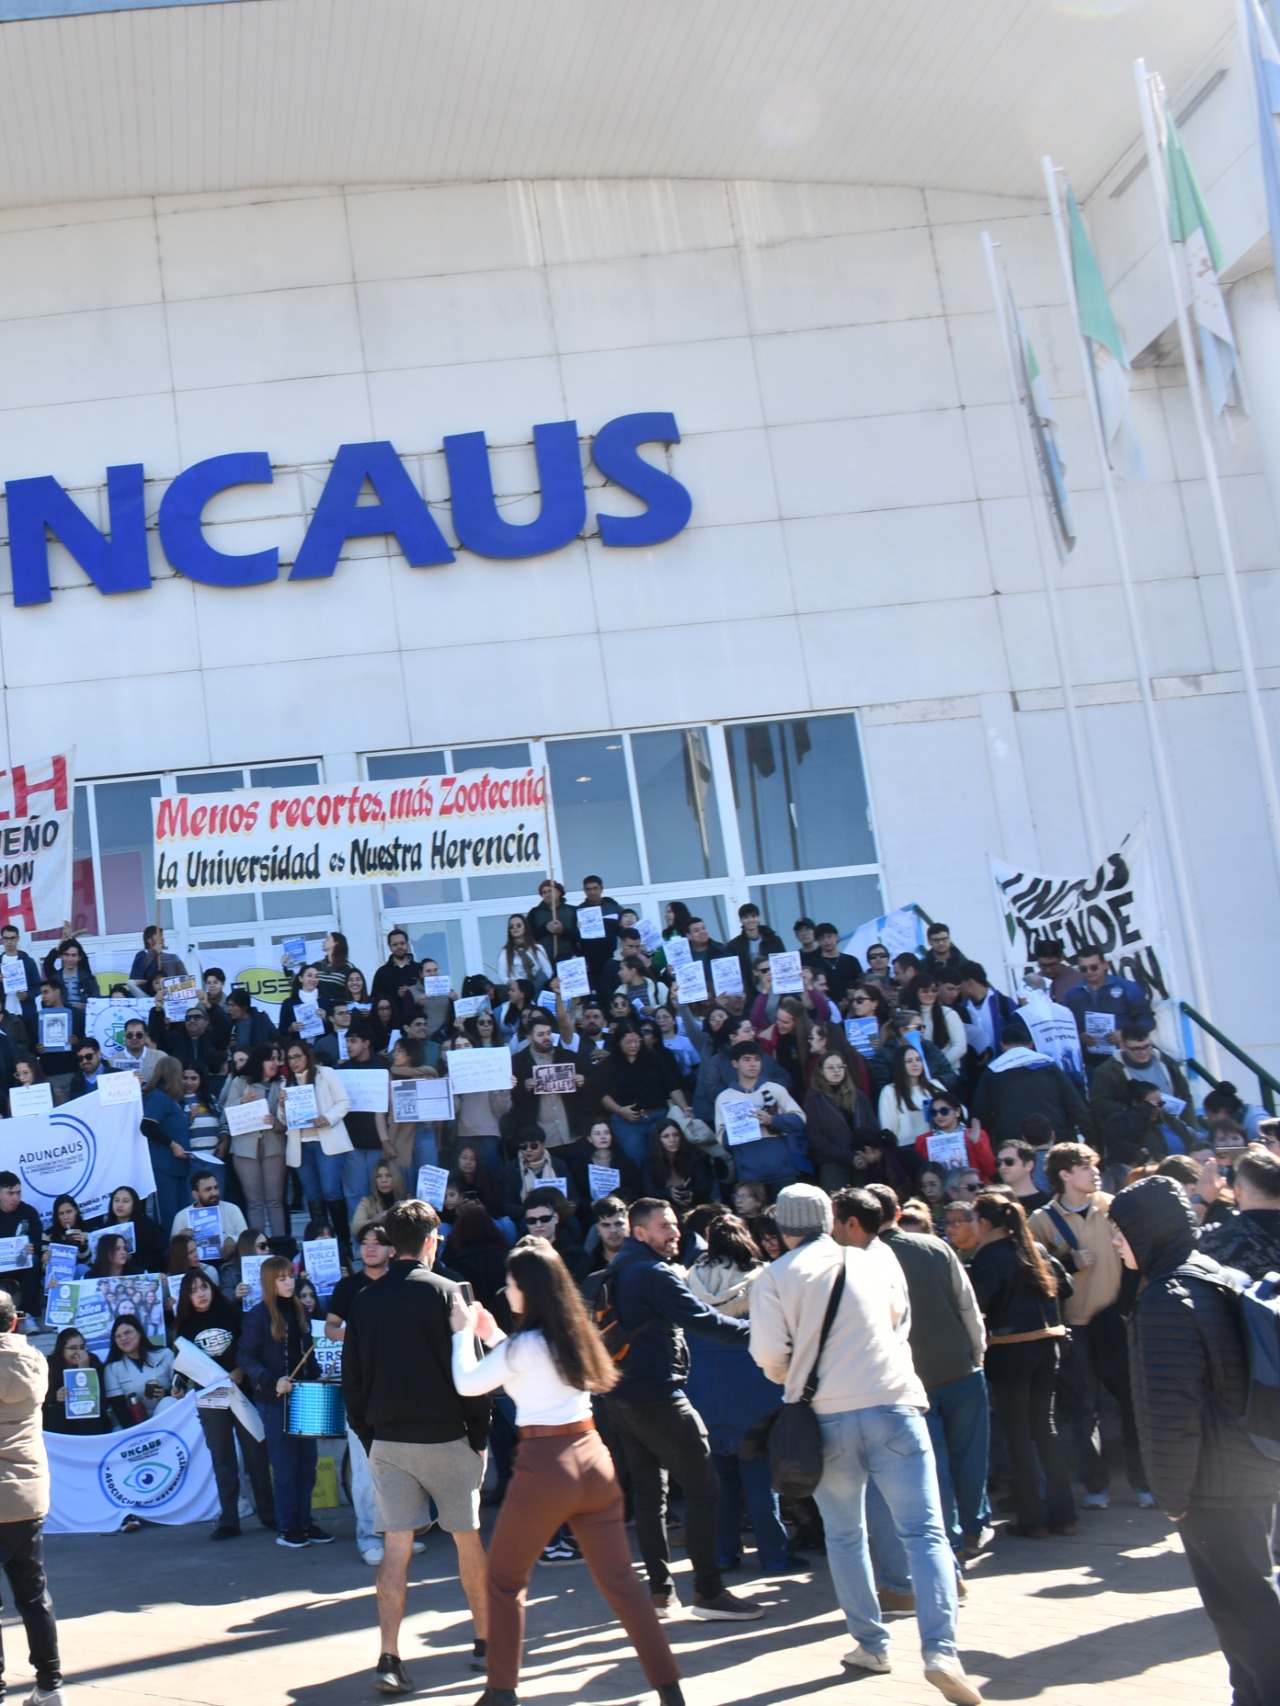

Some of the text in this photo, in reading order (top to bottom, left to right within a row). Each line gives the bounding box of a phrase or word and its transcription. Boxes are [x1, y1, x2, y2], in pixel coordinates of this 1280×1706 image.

[155, 767, 546, 840] Menos recortes, más Zootecnia
[186, 842, 321, 889] Universidad
[329, 853, 346, 873] es
[349, 836, 423, 876] Nuestra
[431, 823, 541, 872] Herencia
[231, 976, 293, 996] FUSE
[19, 1140, 84, 1165] ADUNCAUS
[120, 1438, 162, 1459] UNCAUS
